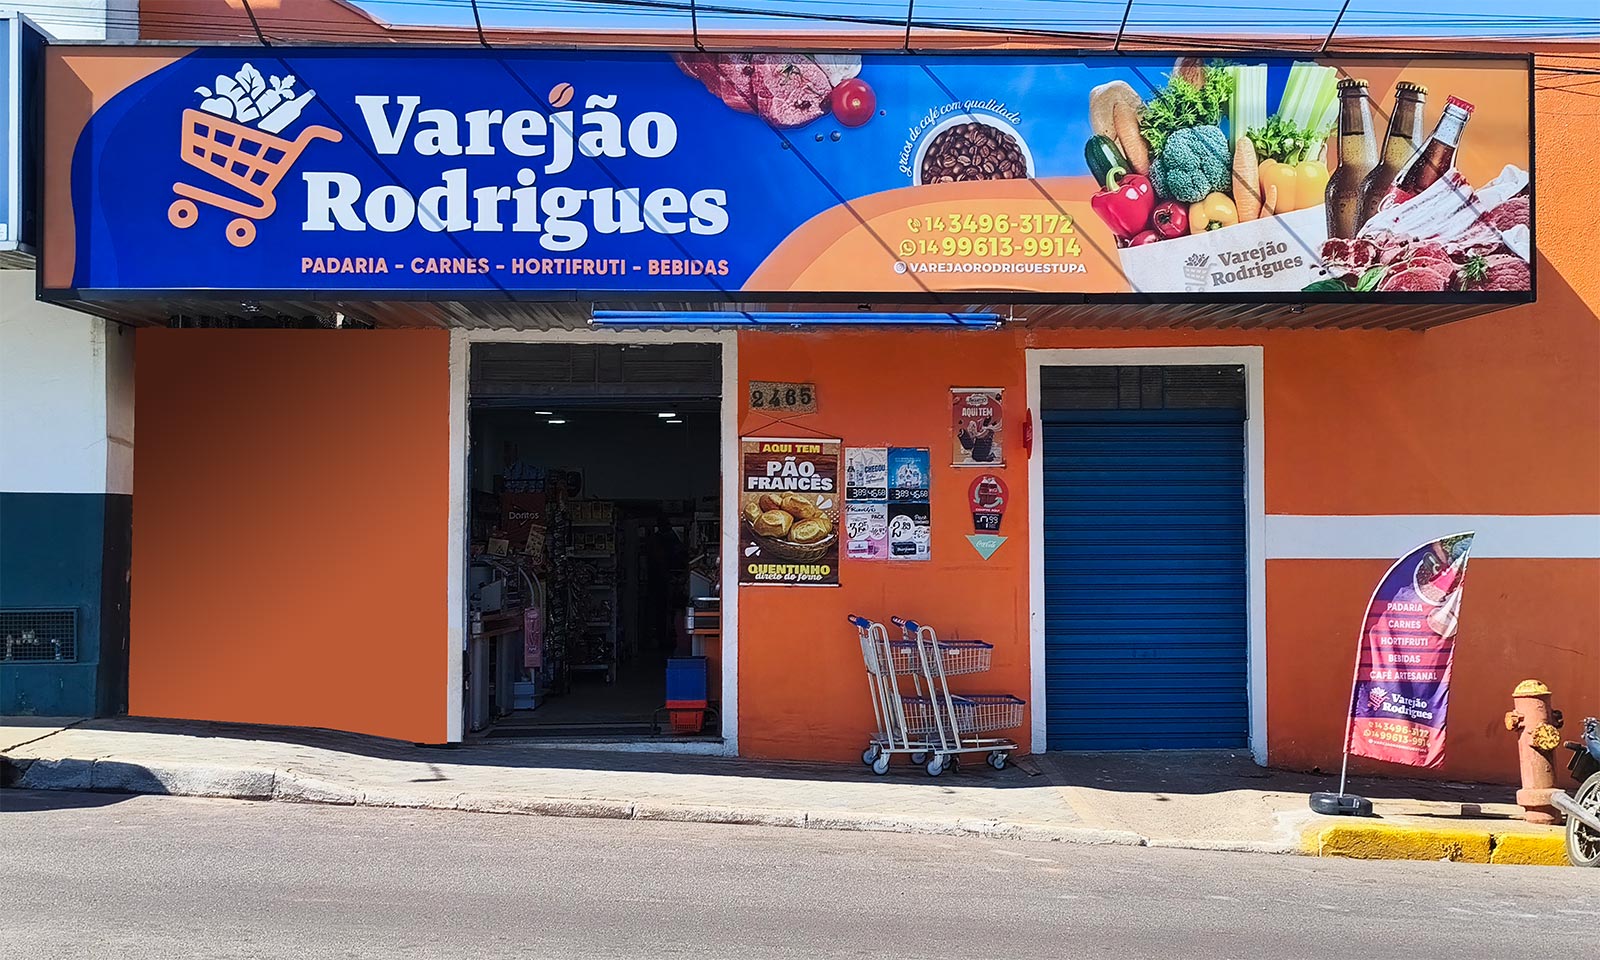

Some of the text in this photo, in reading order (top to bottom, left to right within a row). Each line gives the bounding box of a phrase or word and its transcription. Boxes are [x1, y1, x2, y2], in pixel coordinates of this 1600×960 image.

[355, 84, 678, 175] Varejão
[898, 99, 1021, 178] grãos de café com qualidade
[301, 168, 730, 252] Rodrigues
[925, 214, 1075, 234] 14 3496-3172
[918, 237, 1082, 258] 14 99613-9914
[1217, 241, 1288, 267] Varejão
[301, 257, 389, 275] PADARIA
[410, 257, 490, 275] CARNES
[511, 257, 626, 276] HORTIFRUTI
[648, 258, 730, 276] BEBIDAS
[909, 263, 1087, 274] VAREJAORODRIGUESTUPA
[1210, 255, 1304, 287] Rodrigues
[751, 387, 812, 408] 2465
[961, 407, 993, 418] AQUI TEM
[762, 444, 821, 454] AQUI TEM
[766, 456, 816, 477] PÃO
[747, 474, 834, 491] FRANCÊS
[508, 511, 540, 520] Doritos
[747, 563, 831, 575] QUENTINHO
[754, 572, 824, 582] direto do forno
[1386, 602, 1424, 612] PADARIA
[1388, 620, 1422, 629] CARNES
[1380, 636, 1429, 647] HORTIFRUTI
[1388, 654, 1421, 663] BEBIDAS
[1369, 669, 1438, 680] CAFÉ ARTESANAL
[1391, 693, 1428, 709] Varejão
[1382, 702, 1433, 720] Rodrigues
